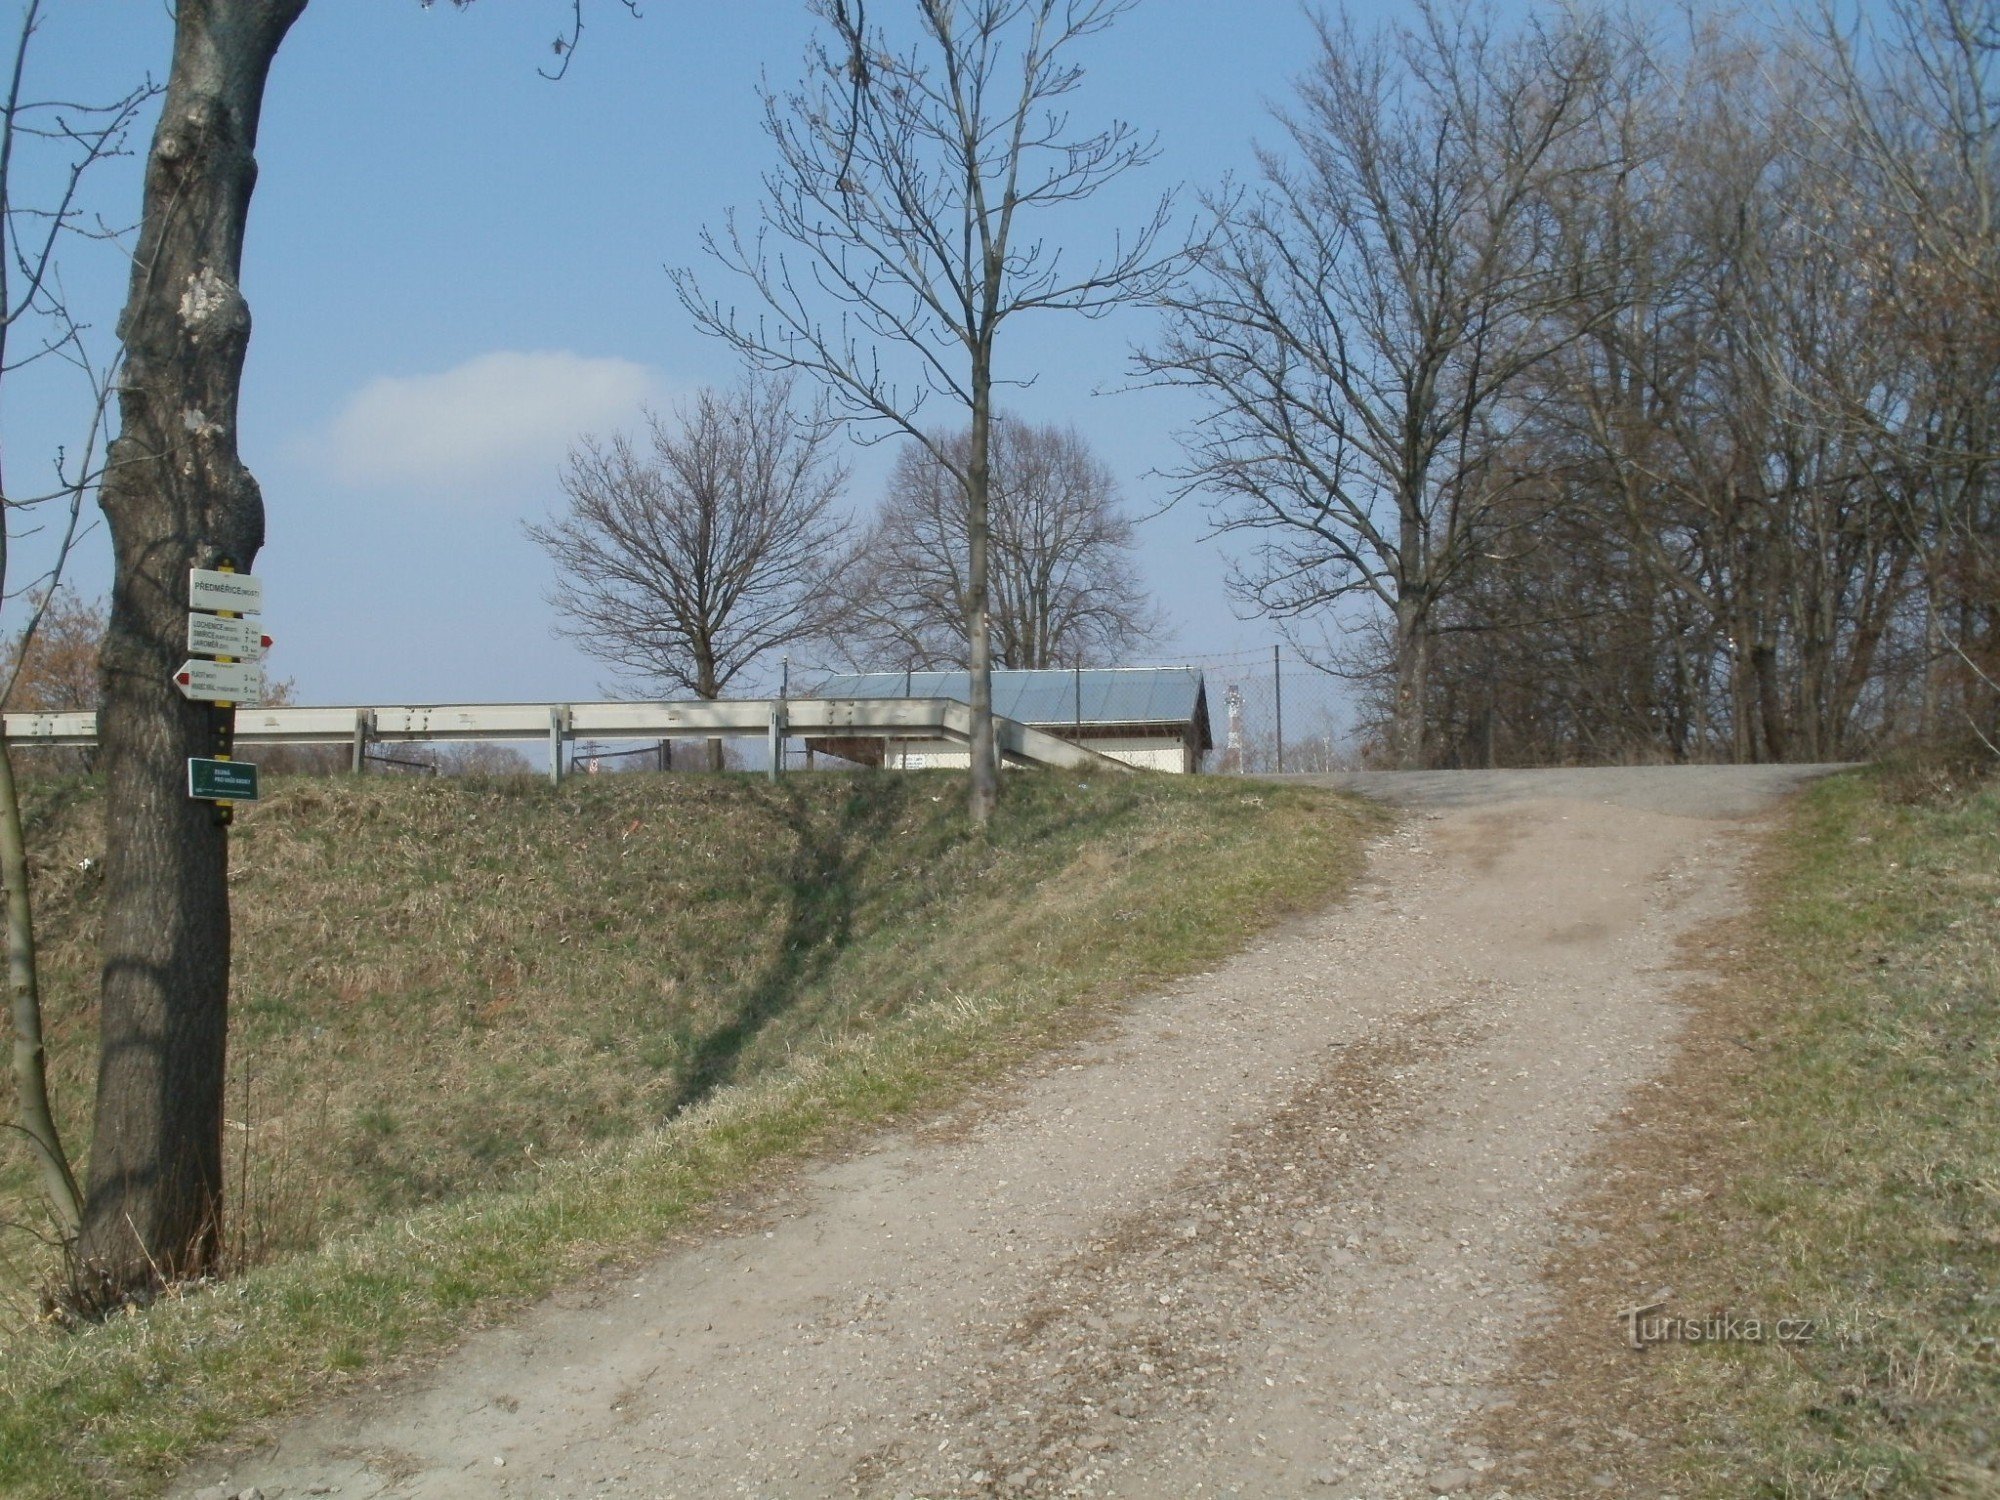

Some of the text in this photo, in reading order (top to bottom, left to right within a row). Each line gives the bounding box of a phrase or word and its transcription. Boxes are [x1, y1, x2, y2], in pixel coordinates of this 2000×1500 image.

[195, 581, 241, 595] PŘEDMĚŘICE
[245, 626, 250, 635] 2
[241, 645, 249, 653] 13
